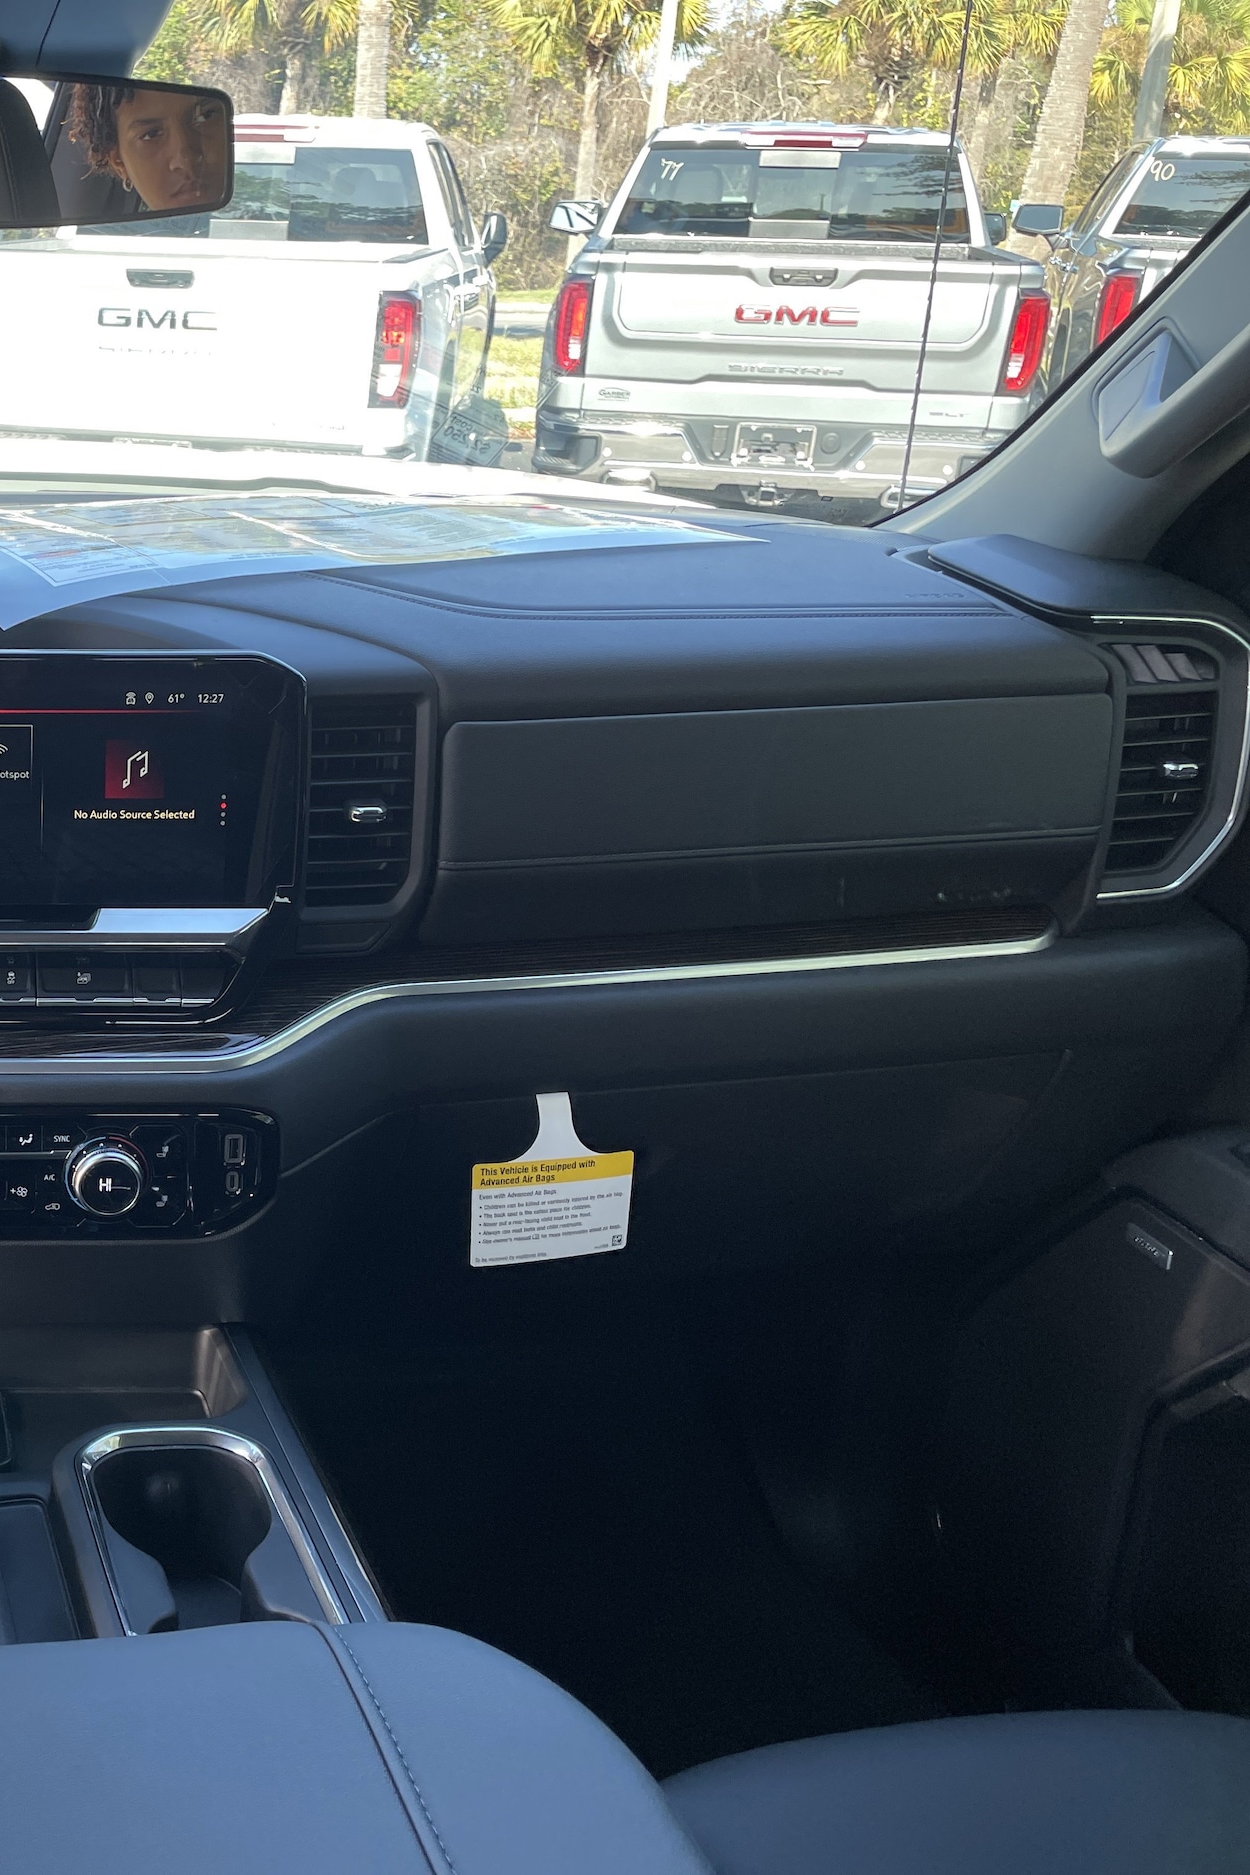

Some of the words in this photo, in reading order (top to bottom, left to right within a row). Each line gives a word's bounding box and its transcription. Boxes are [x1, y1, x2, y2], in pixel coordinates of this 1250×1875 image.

[1150, 160, 1176, 182] 90
[97, 307, 218, 331] GMC
[735, 303, 861, 327] GMC
[197, 693, 225, 704] 12:27
[74, 810, 88, 819] No
[90, 809, 117, 819] Audio
[119, 810, 152, 819] Source
[154, 809, 195, 819] Selected
[53, 1135, 71, 1143] SYNC
[480, 1167, 498, 1177] This
[500, 1165, 529, 1176] Vehicle
[531, 1164, 538, 1173] is
[540, 1162, 577, 1174] Equipped
[579, 1159, 596, 1169] with
[44, 1173, 56, 1181] A/C
[480, 1175, 520, 1187] Advanced
[522, 1174, 534, 1184] Air
[535, 1173, 556, 1184] Bags
[99, 1178, 112, 1192] HI
